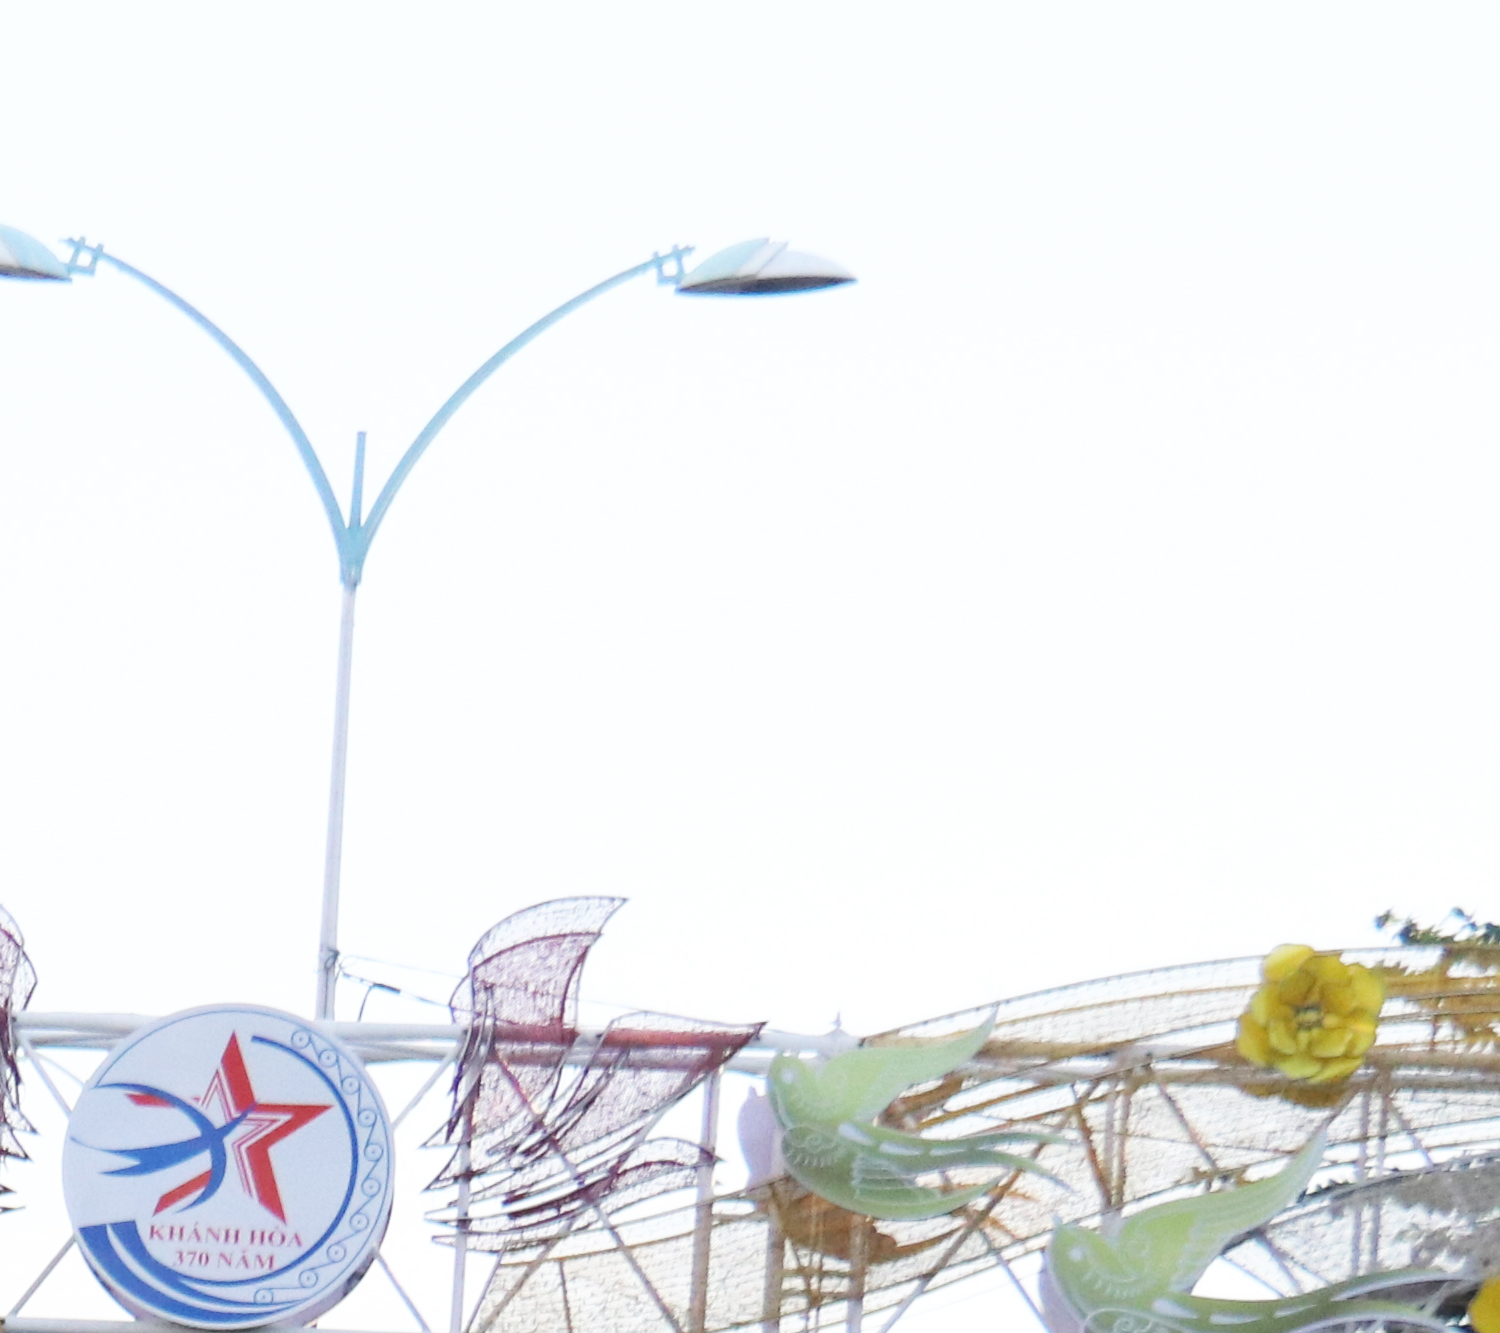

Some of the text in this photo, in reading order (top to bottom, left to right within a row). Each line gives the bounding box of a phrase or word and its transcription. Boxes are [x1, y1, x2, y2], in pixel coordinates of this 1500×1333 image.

[149, 1219, 304, 1248] KHÁNH HÒA
[171, 1248, 276, 1271] 370 NĂM
